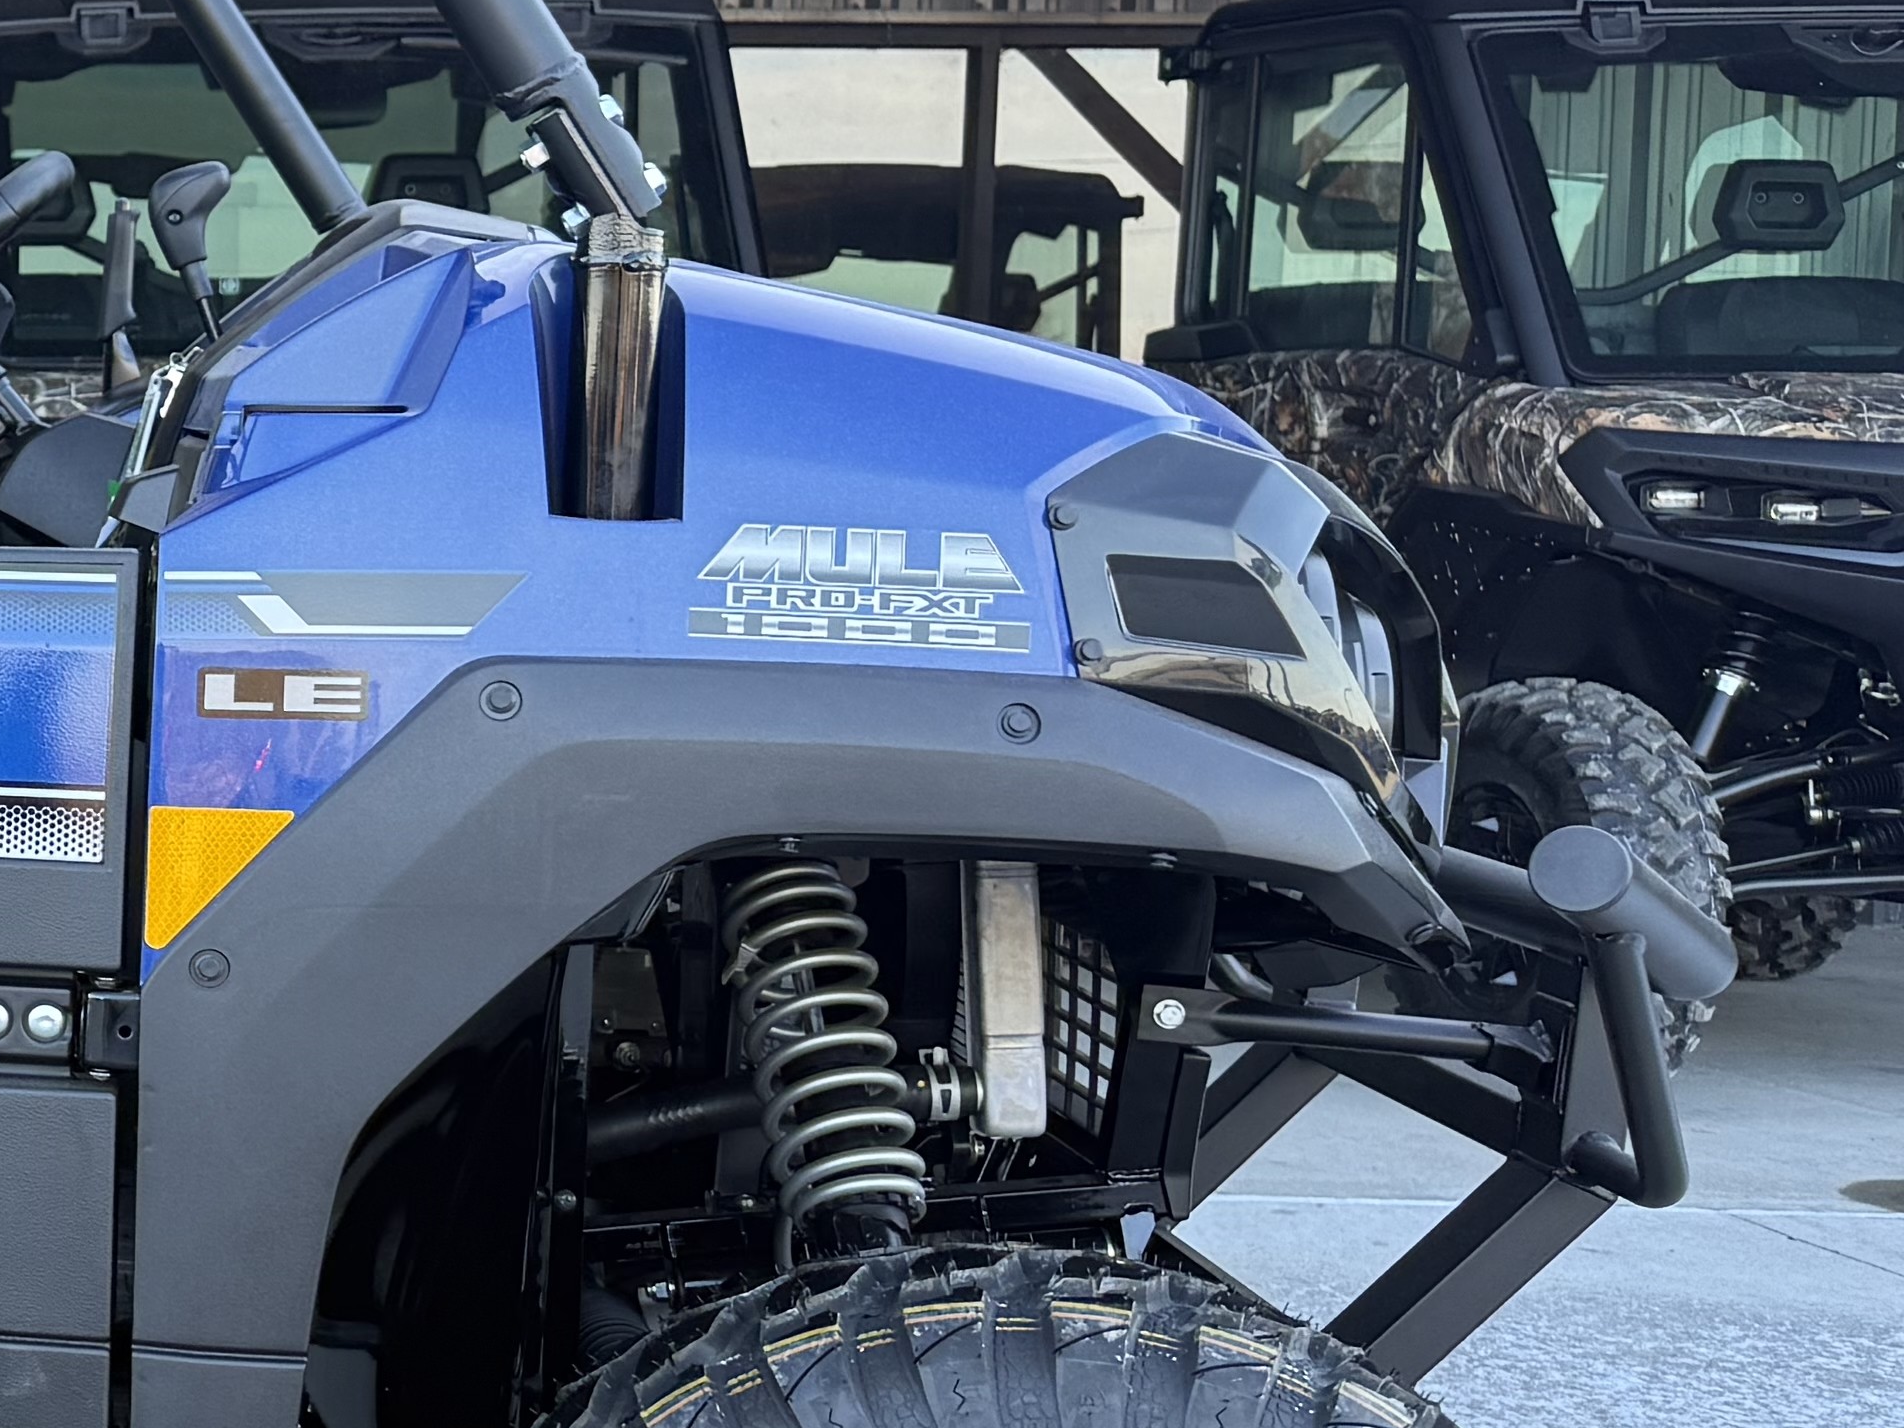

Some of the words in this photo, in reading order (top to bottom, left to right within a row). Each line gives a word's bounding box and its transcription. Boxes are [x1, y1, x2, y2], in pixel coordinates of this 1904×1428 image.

[696, 523, 1025, 594] MULE
[726, 582, 994, 619] PRO-FXT
[720, 612, 997, 646] 1000
[203, 673, 362, 714] LE
